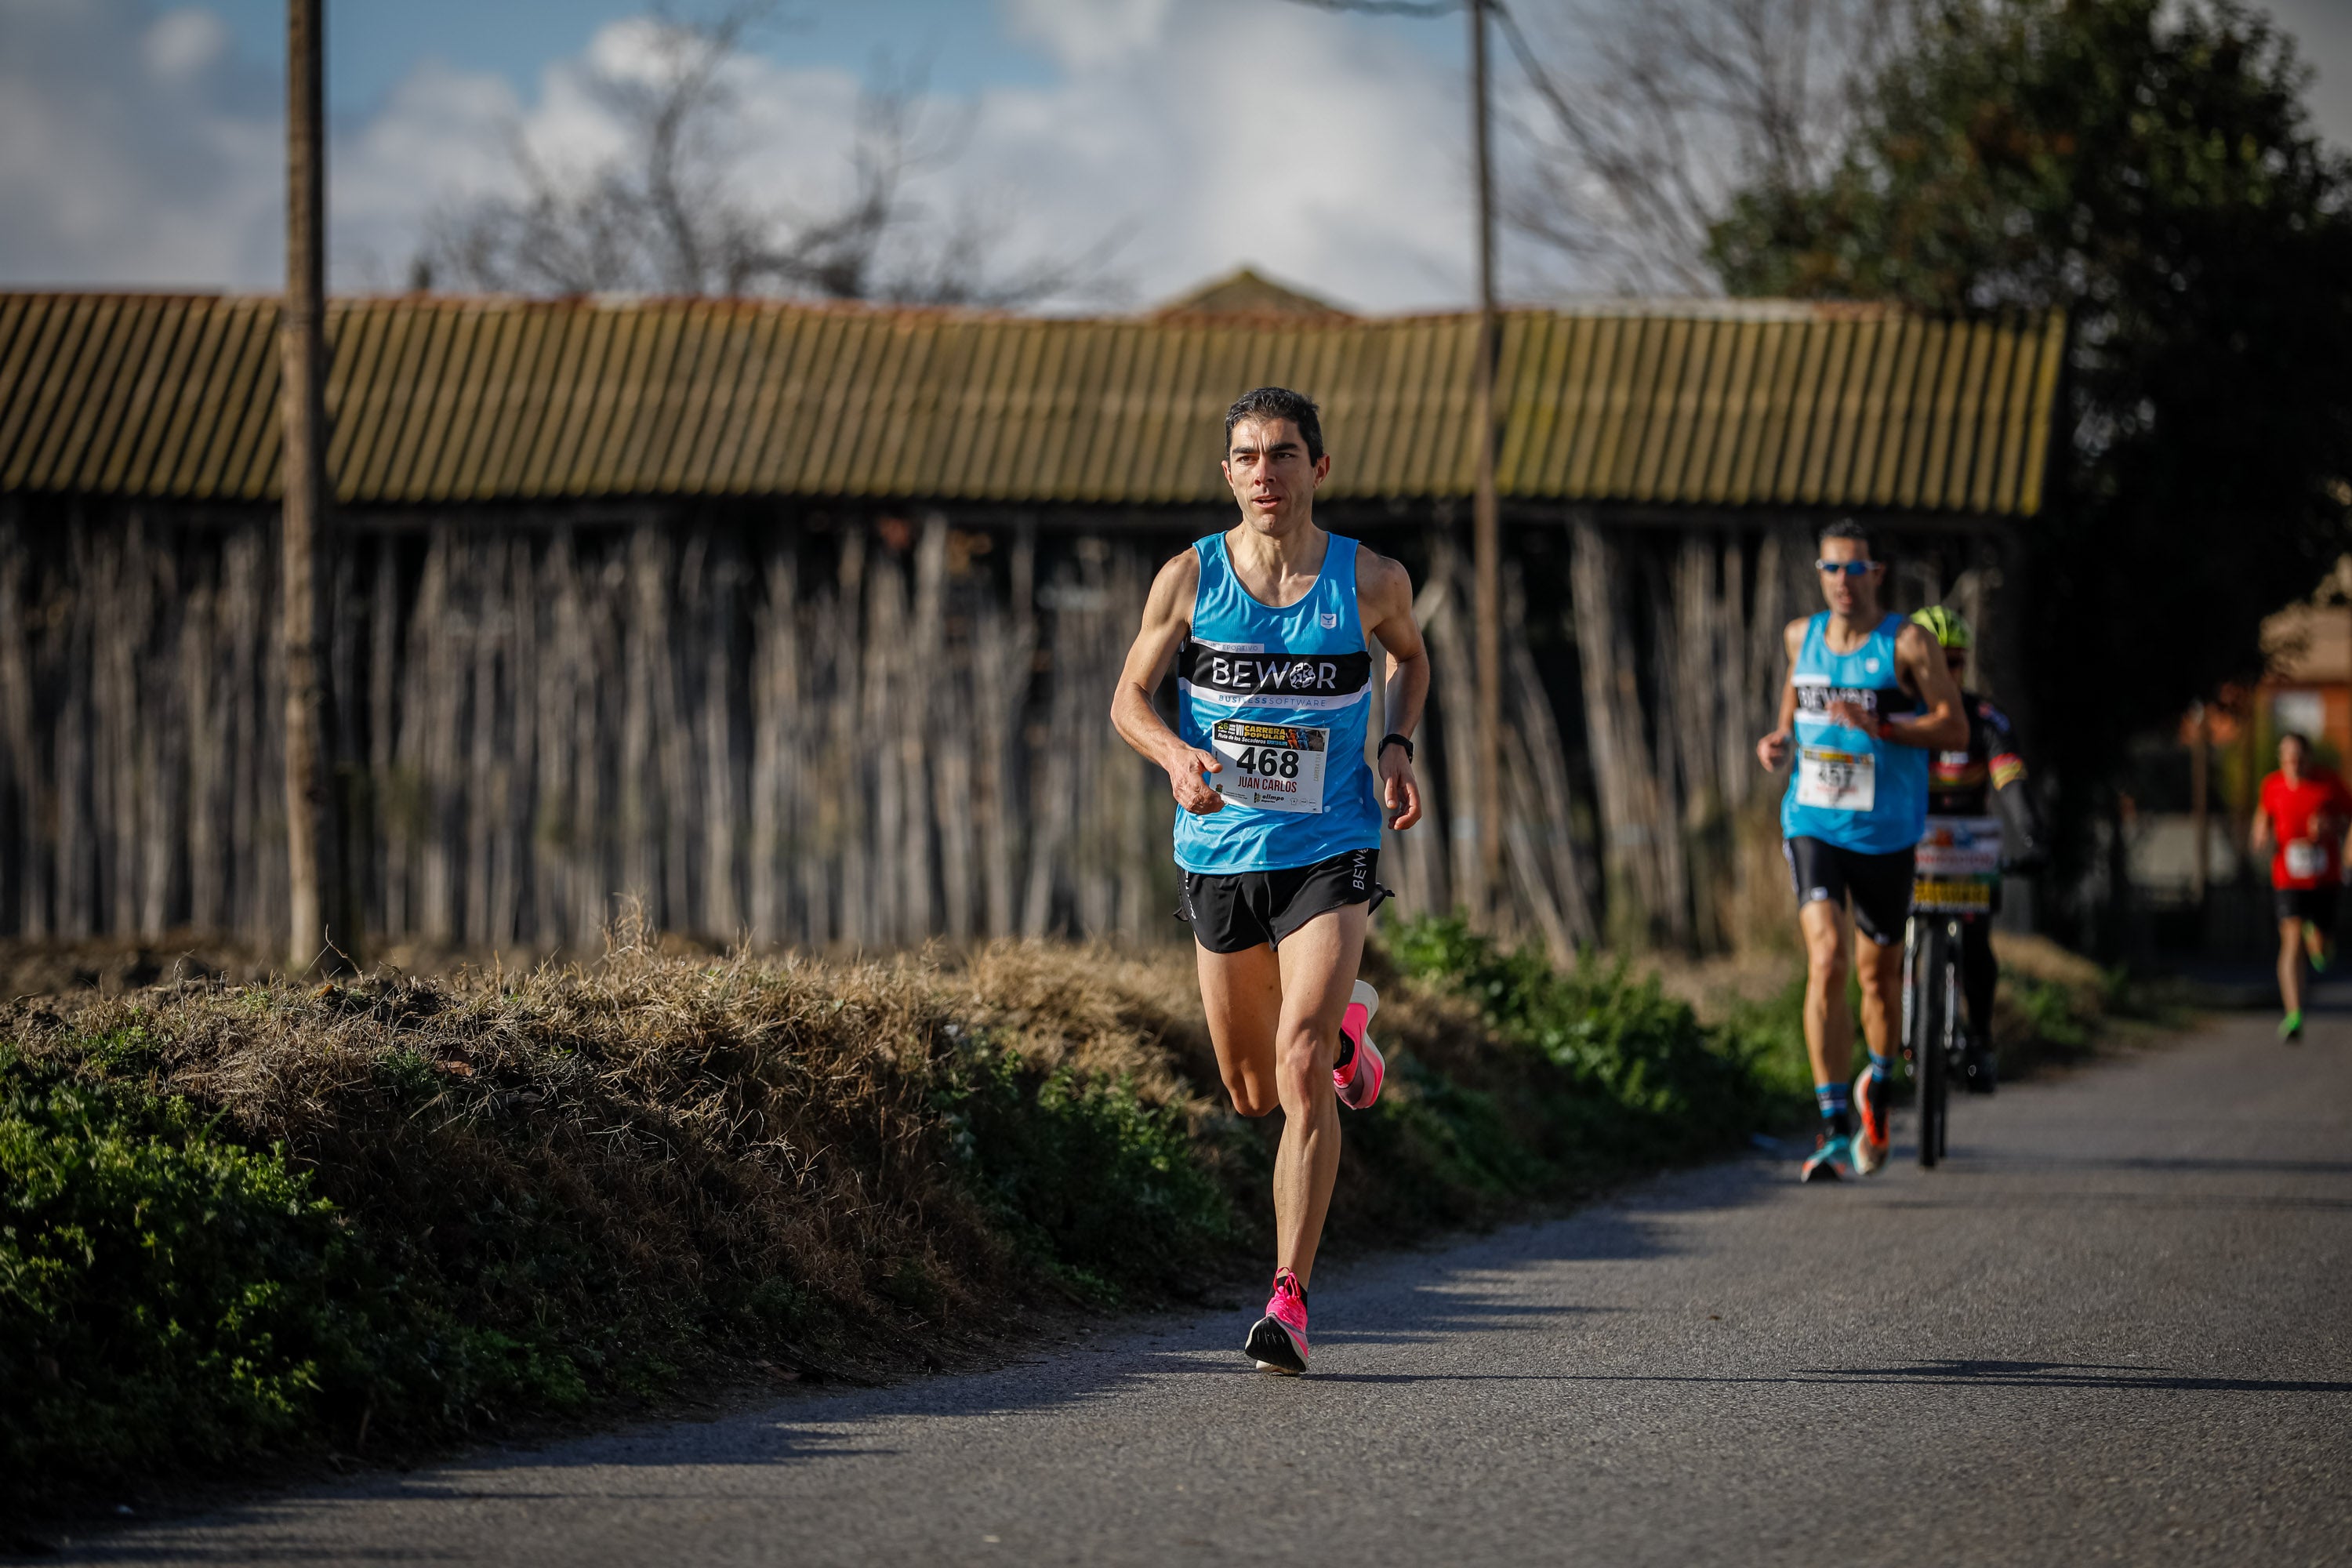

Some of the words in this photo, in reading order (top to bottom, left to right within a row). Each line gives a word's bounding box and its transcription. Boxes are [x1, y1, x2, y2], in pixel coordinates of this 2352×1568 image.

[1236, 724, 1244, 736] VII
[1244, 725, 1286, 735] CARRERA
[1244, 731, 1286, 740] POPULAR
[1236, 746, 1300, 779] 468
[1237, 776, 1260, 789] JUAN
[1261, 779, 1298, 793] CARLOS
